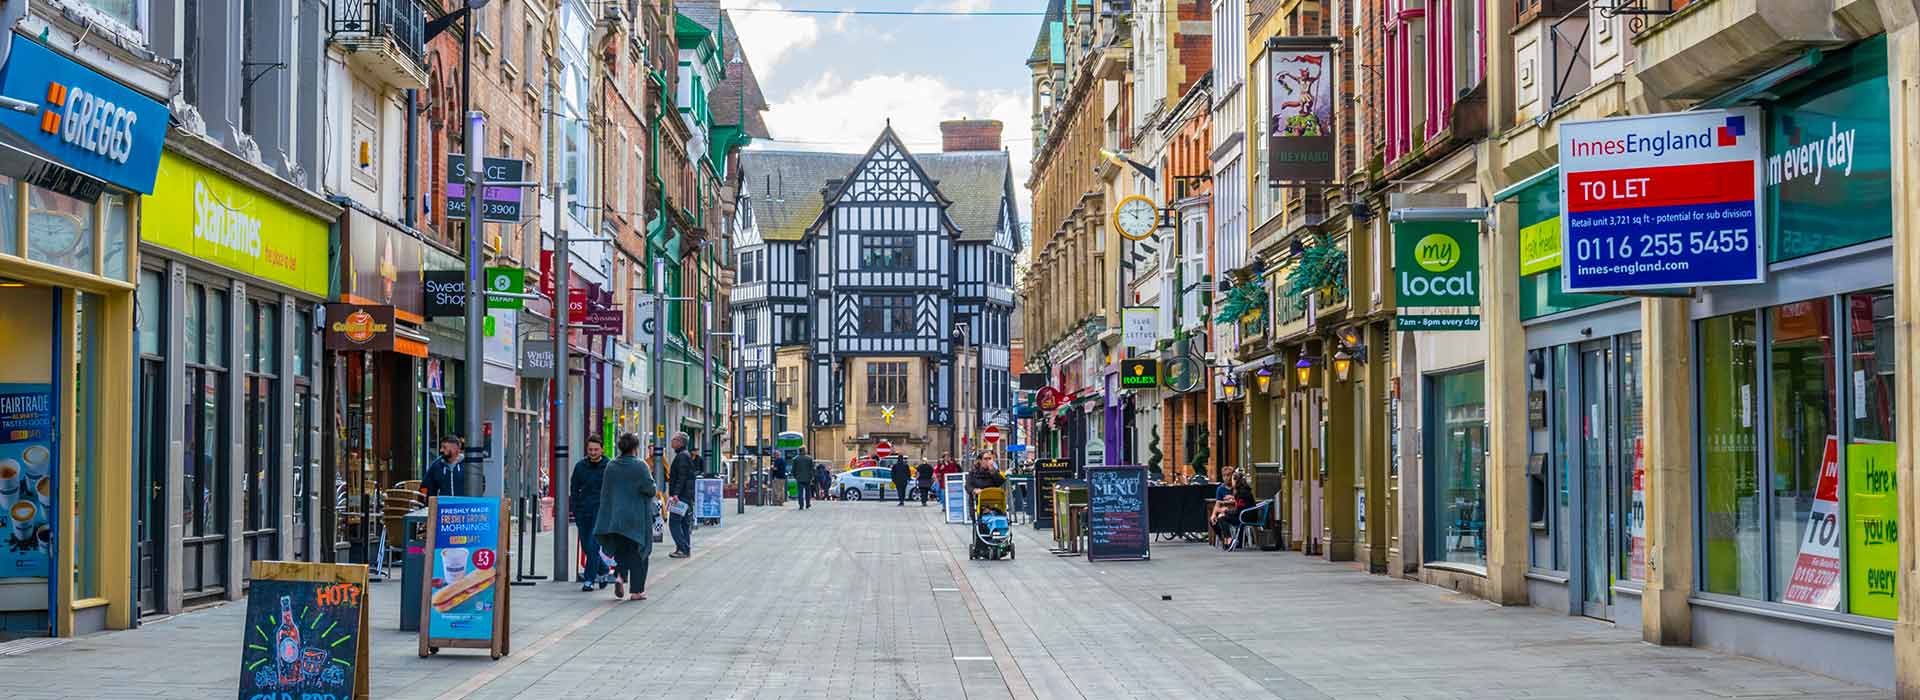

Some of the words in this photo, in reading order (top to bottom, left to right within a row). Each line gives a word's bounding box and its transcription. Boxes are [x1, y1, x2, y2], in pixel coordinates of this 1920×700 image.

[63, 87, 137, 164] GREGGS
[1571, 128, 1712, 157] InnesEngland
[1784, 139, 1824, 185] every
[1827, 121, 1856, 177] day
[455, 162, 507, 180] SCE
[1580, 181, 1606, 201] TO
[1613, 177, 1651, 199] LET
[491, 204, 516, 215] 3900
[1571, 217, 1592, 228] Retail
[1593, 216, 1609, 227] unit
[1609, 215, 1630, 227] 3,721
[1632, 216, 1642, 227] sq
[1643, 212, 1651, 224] ft
[1656, 210, 1692, 224] potential
[1692, 209, 1705, 221] for
[1706, 209, 1721, 219] sub
[1721, 208, 1752, 219] division
[1423, 243, 1452, 267] my
[1577, 235, 1633, 261] 0116
[1639, 232, 1683, 258] 255
[1689, 228, 1749, 255] 5455
[1577, 260, 1689, 276] innes-england.com
[1402, 271, 1475, 297] local
[1400, 318, 1416, 326] 7am
[1422, 318, 1441, 327] 8pm
[1441, 319, 1463, 327] every
[1464, 317, 1479, 327] day
[1123, 376, 1156, 385] ROLEX
[0, 394, 49, 414] FAIRTRADE
[1866, 457, 1889, 492] Here
[1093, 483, 1139, 496] MENU
[441, 522, 490, 532] MORNINGS
[1811, 511, 1837, 547] TO
[1864, 518, 1883, 545] you
[478, 551, 489, 566] £3
[1867, 567, 1896, 598] every
[317, 583, 360, 607] HOT?
